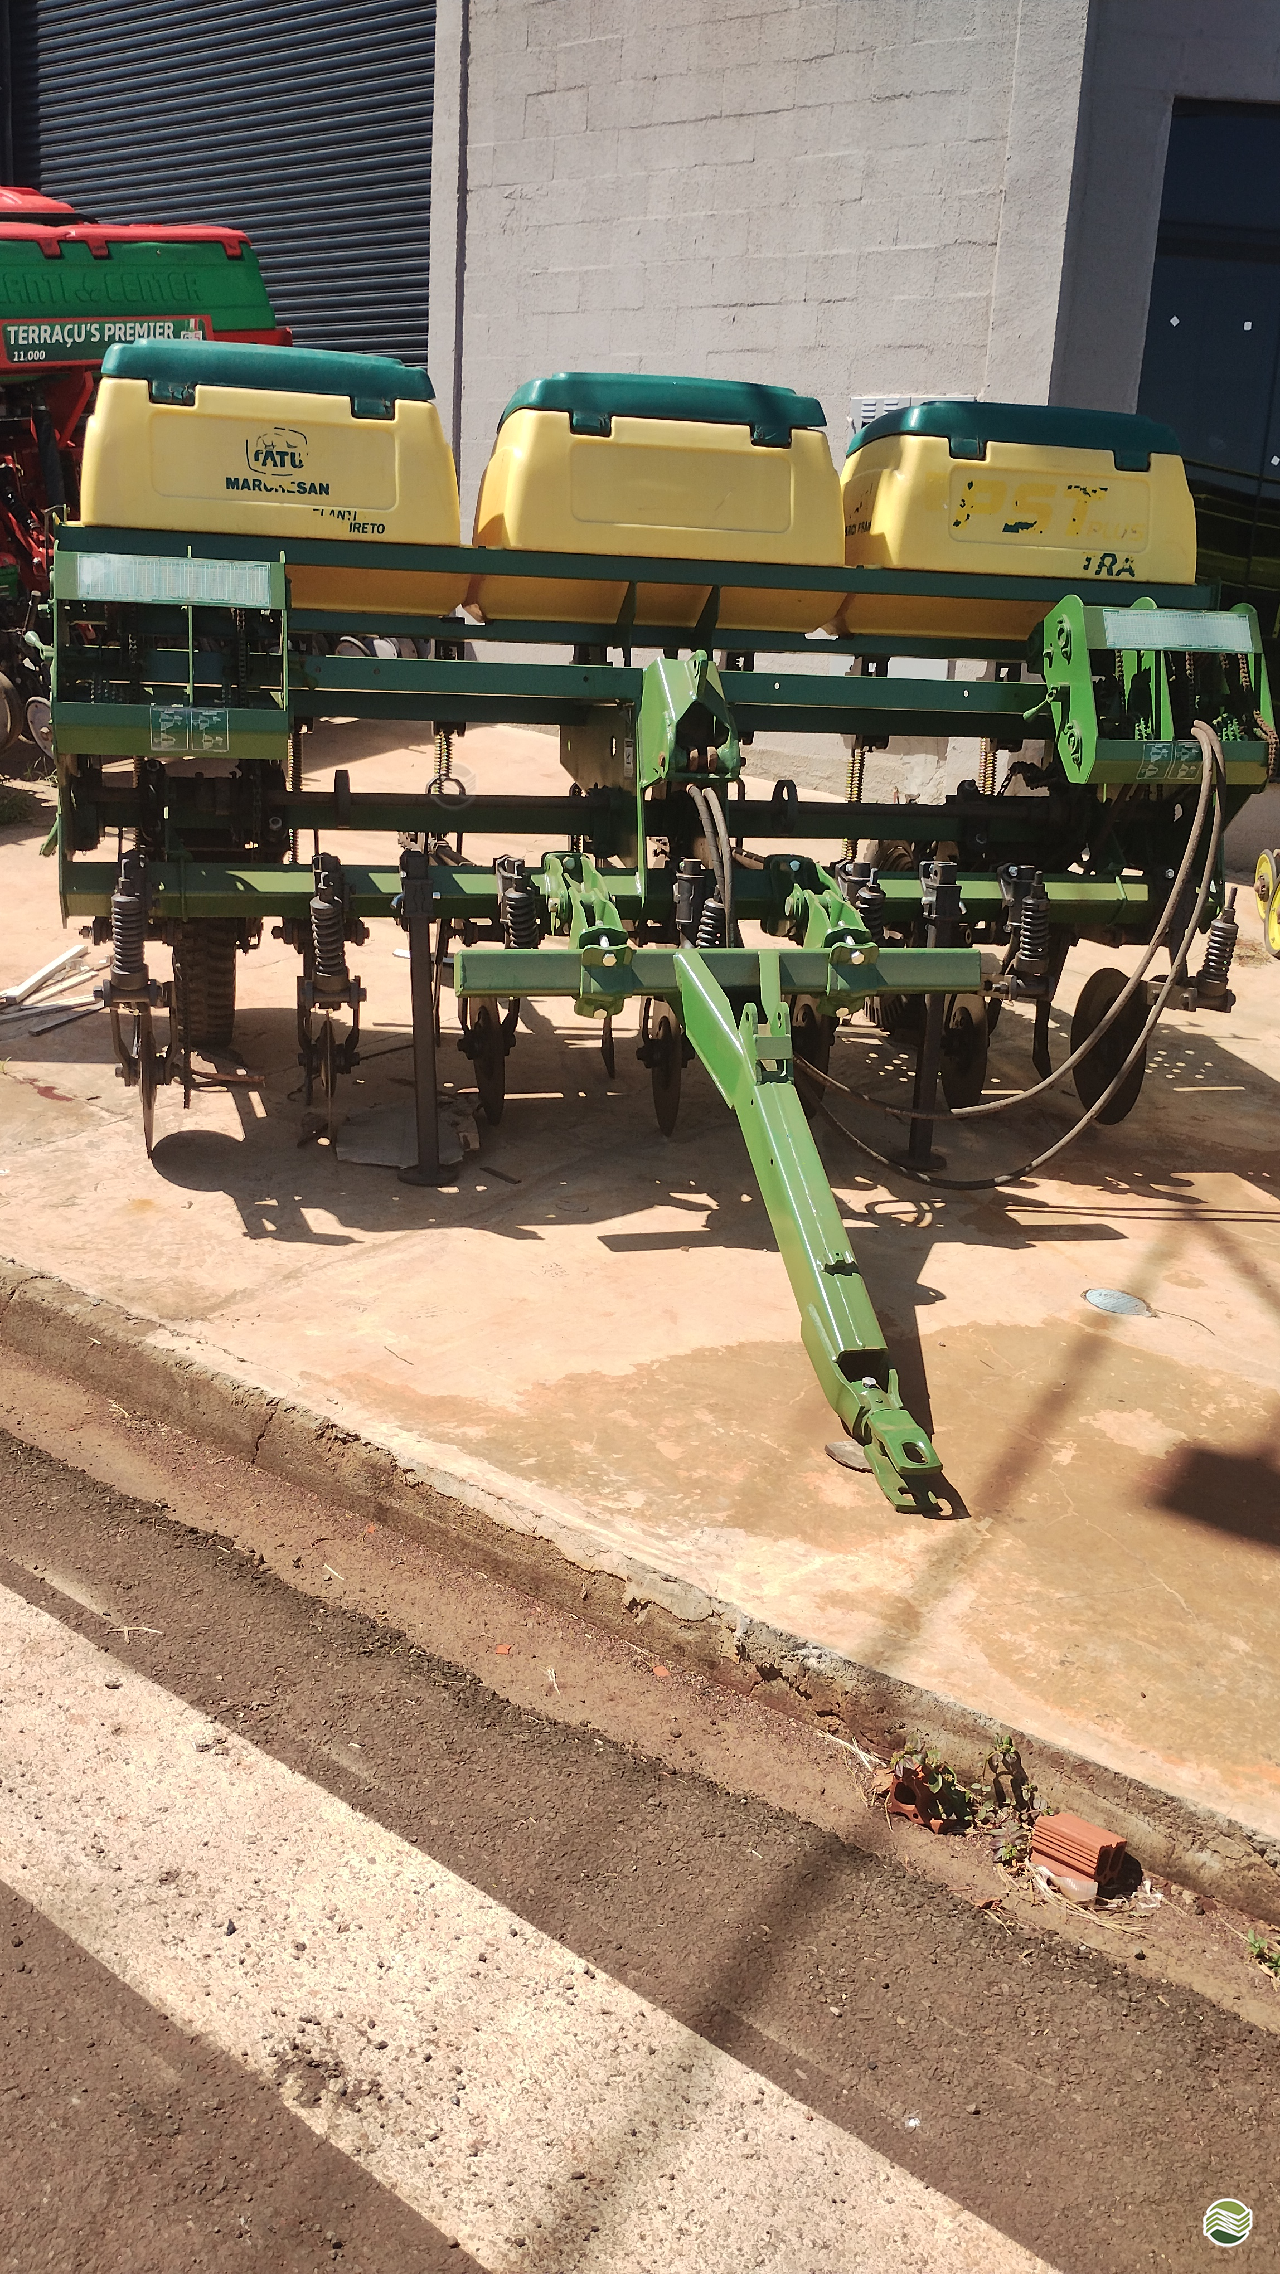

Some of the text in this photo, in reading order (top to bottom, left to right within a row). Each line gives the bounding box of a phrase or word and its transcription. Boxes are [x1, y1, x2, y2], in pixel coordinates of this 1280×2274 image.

[7, 321, 174, 348] TERRAÇU'S PREMIER
[13, 349, 46, 362] 11.000
